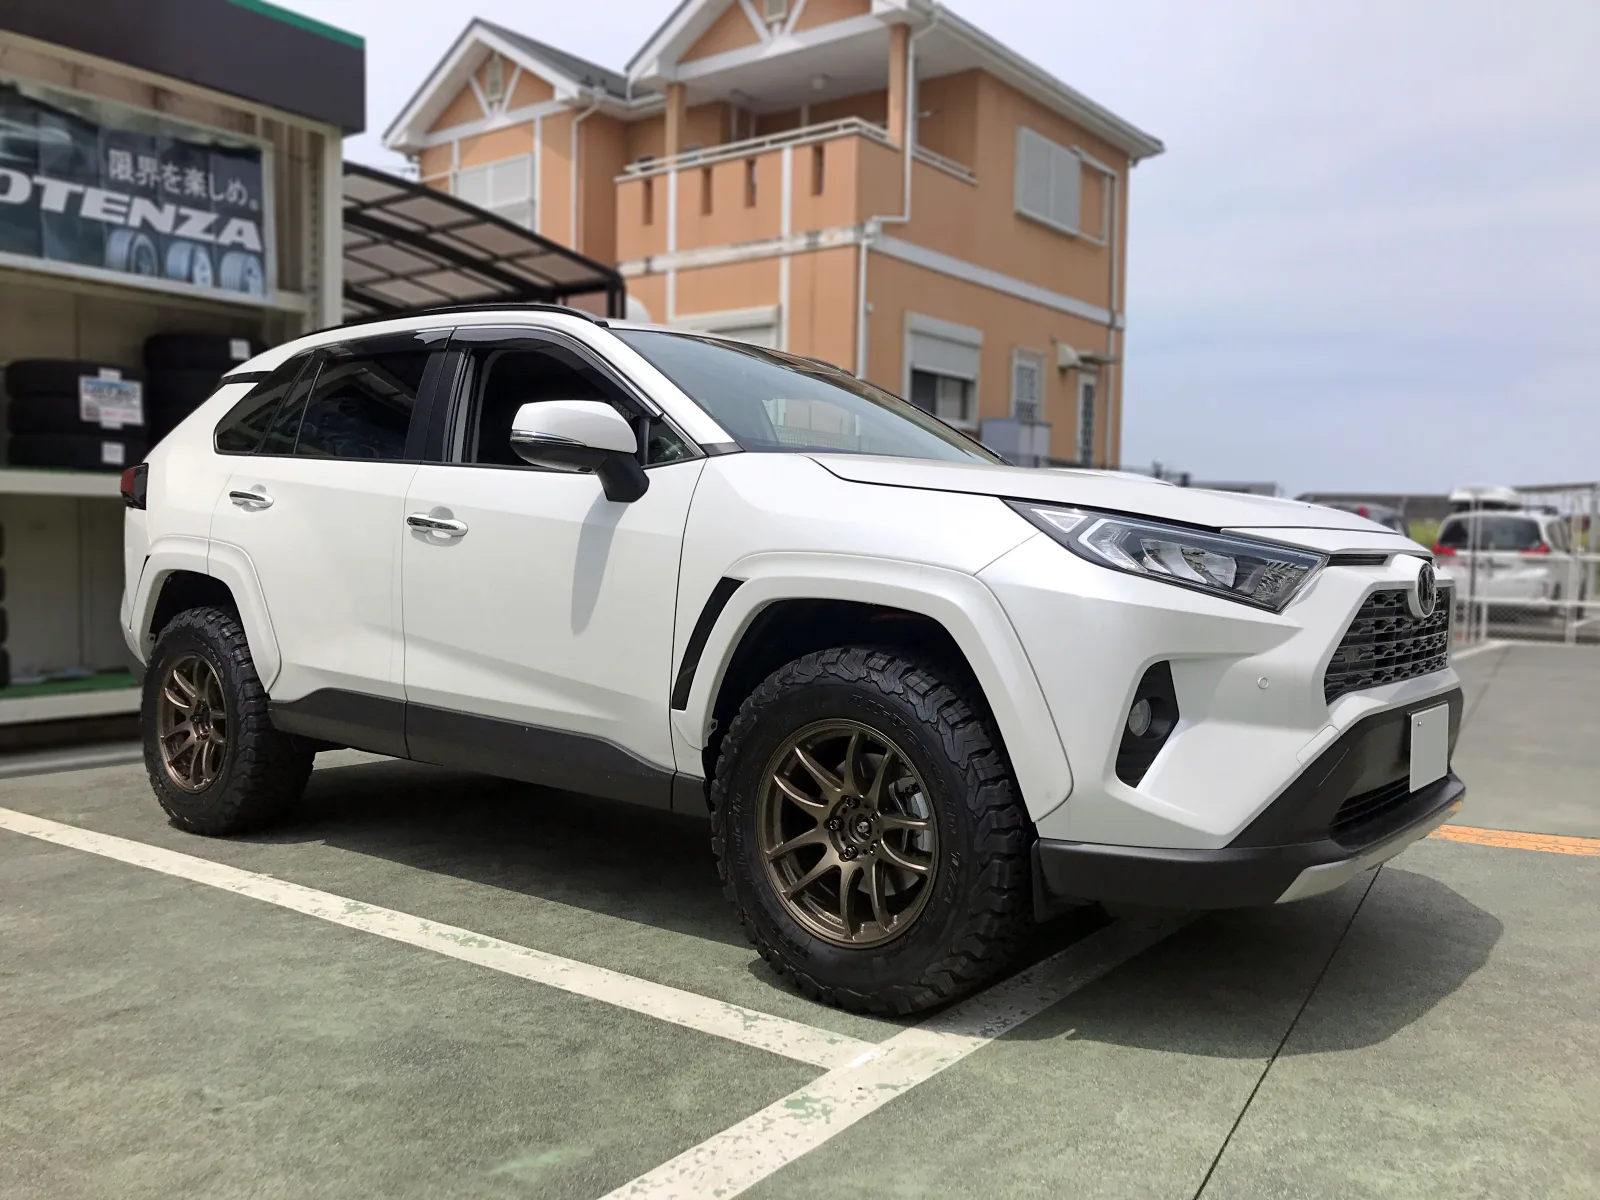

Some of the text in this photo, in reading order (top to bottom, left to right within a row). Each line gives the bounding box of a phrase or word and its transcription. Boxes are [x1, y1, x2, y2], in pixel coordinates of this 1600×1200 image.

[108, 149, 260, 212] 限界を楽しめ。
